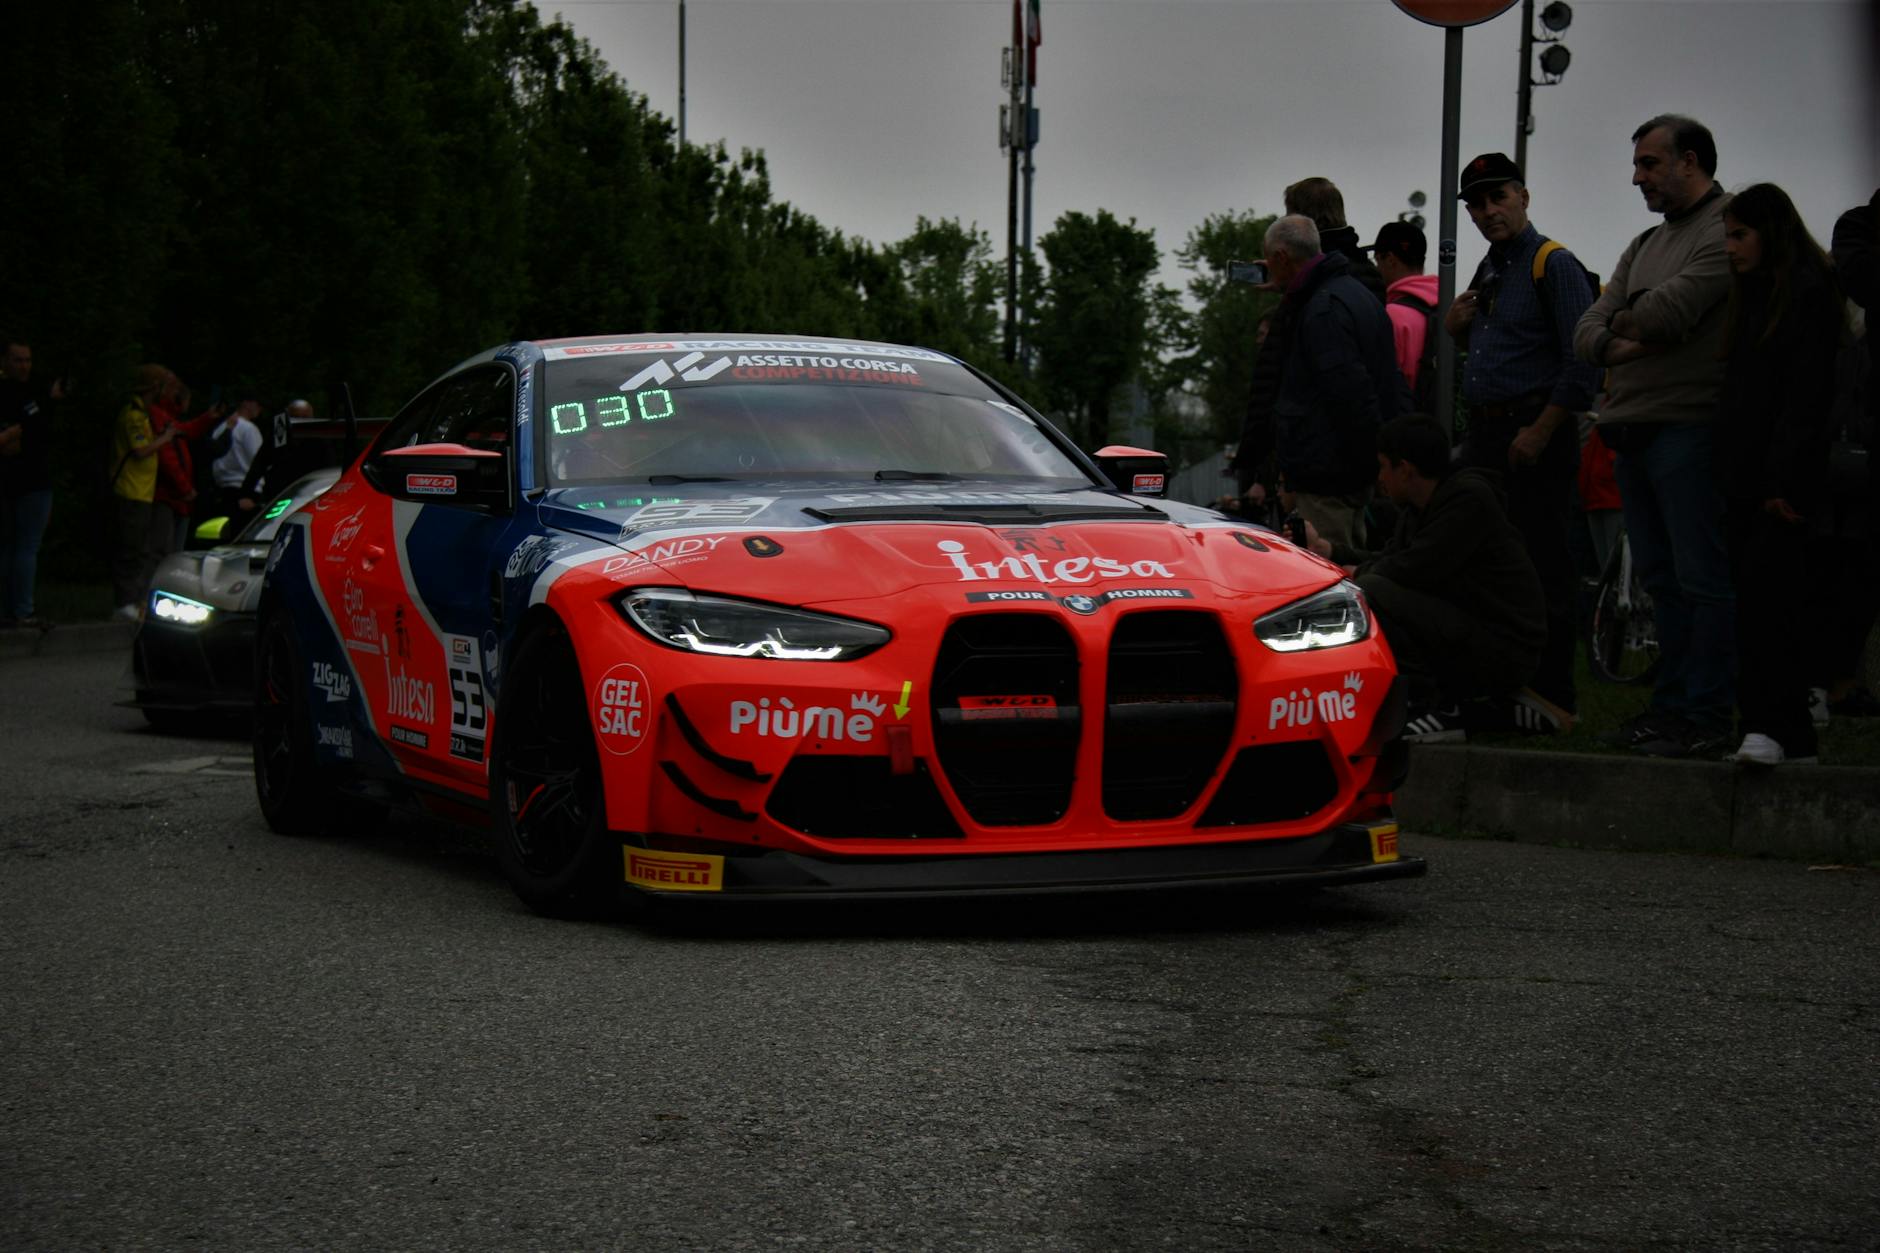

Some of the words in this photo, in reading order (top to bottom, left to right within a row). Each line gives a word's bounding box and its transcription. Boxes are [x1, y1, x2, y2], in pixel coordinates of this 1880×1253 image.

[732, 366, 925, 387] COMPETIZIONE
[736, 355, 839, 369] ASSETTO
[842, 357, 918, 375] CORSA
[550, 388, 676, 435] 030
[602, 536, 727, 574] DANDY
[987, 591, 1045, 601] POUR
[1106, 588, 1185, 599] HOMME
[312, 661, 334, 686] ZIG
[333, 671, 351, 697] ZAG
[600, 677, 642, 708] GEL
[449, 668, 486, 730] 53
[599, 706, 641, 738] SAC
[631, 854, 711, 886] PIRELLI
